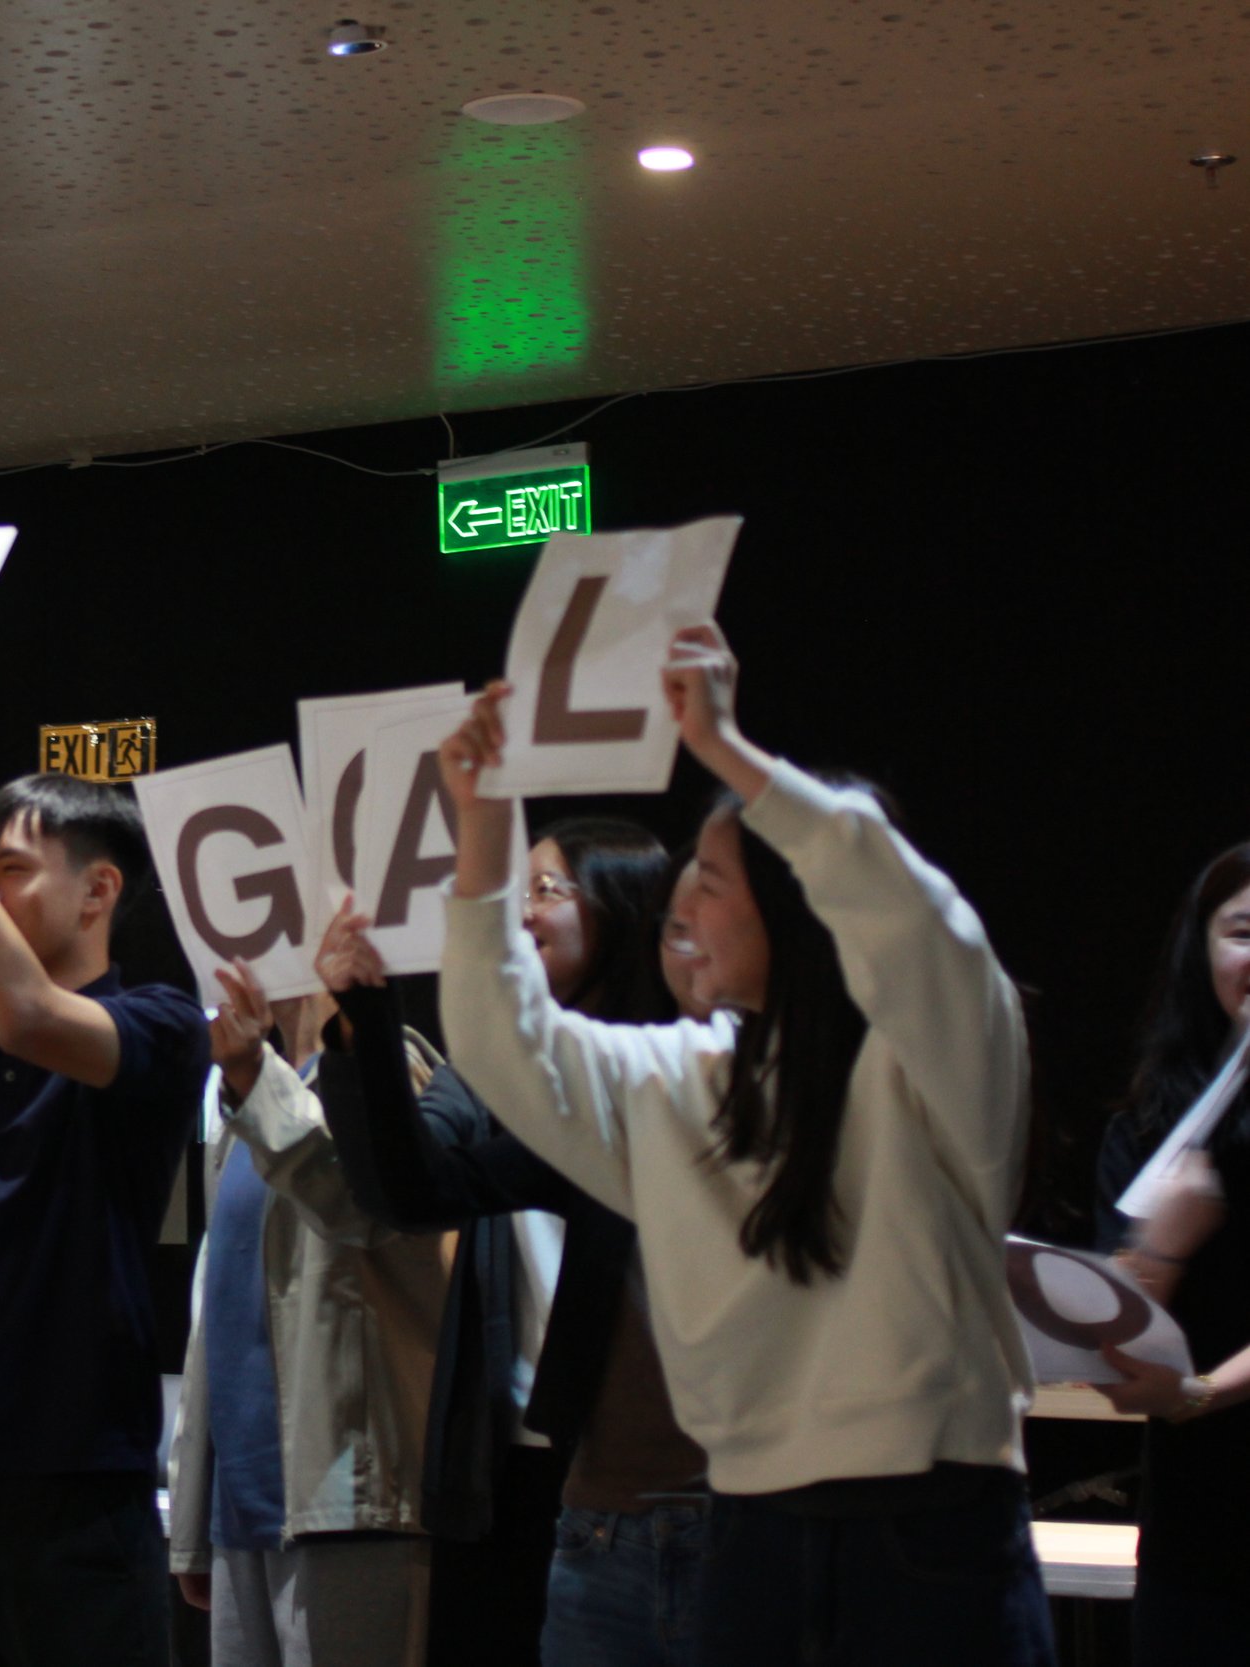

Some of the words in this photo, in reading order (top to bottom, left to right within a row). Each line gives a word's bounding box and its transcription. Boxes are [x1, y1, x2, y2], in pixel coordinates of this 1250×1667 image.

[506, 481, 582, 537] EXIT
[532, 575, 647, 744] L
[47, 732, 107, 774] EXIT
[176, 805, 305, 962] G
